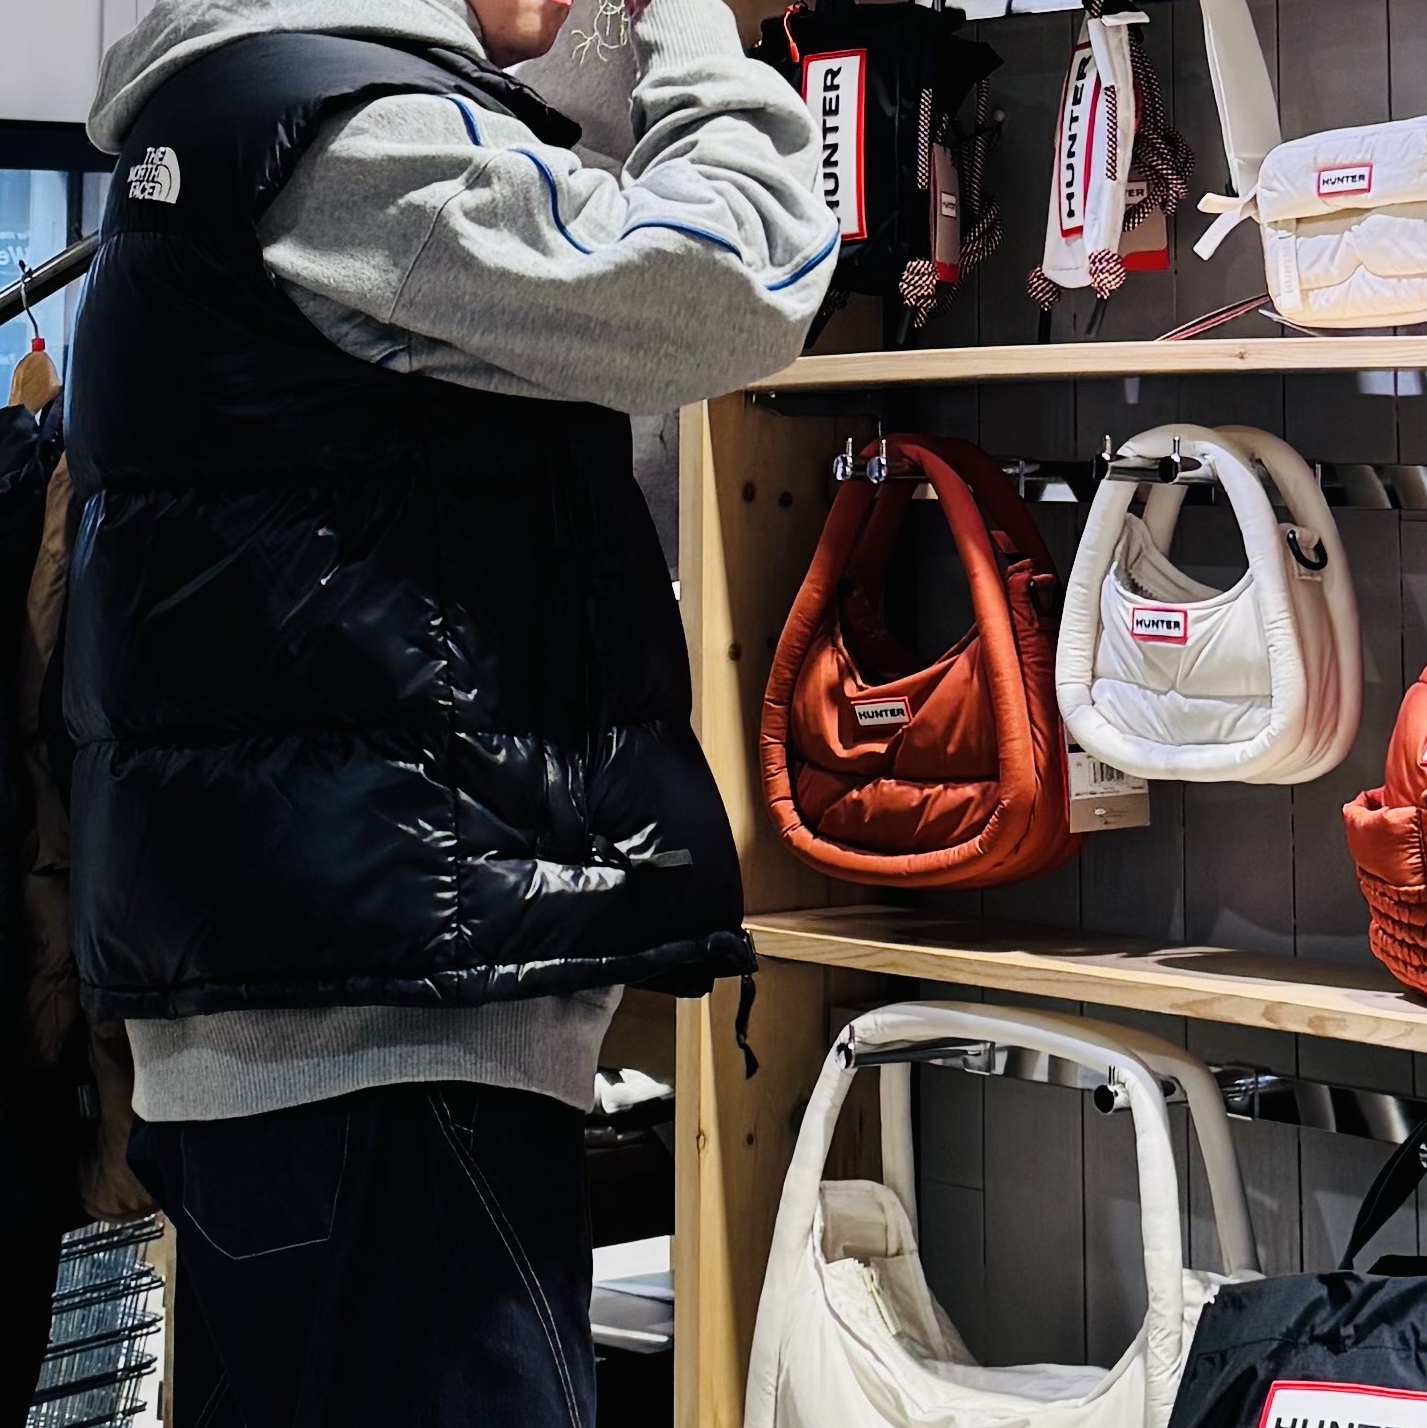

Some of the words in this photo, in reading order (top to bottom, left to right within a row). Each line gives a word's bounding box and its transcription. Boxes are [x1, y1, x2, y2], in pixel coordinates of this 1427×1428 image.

[1065, 55, 1092, 219] HUNTER
[144, 147, 166, 164] THE
[127, 164, 159, 182] NORTH
[1322, 173, 1366, 187] HUNTER
[129, 182, 155, 199] FACE
[1135, 617, 1181, 631] HUNTER
[858, 707, 906, 720] HUNTER
